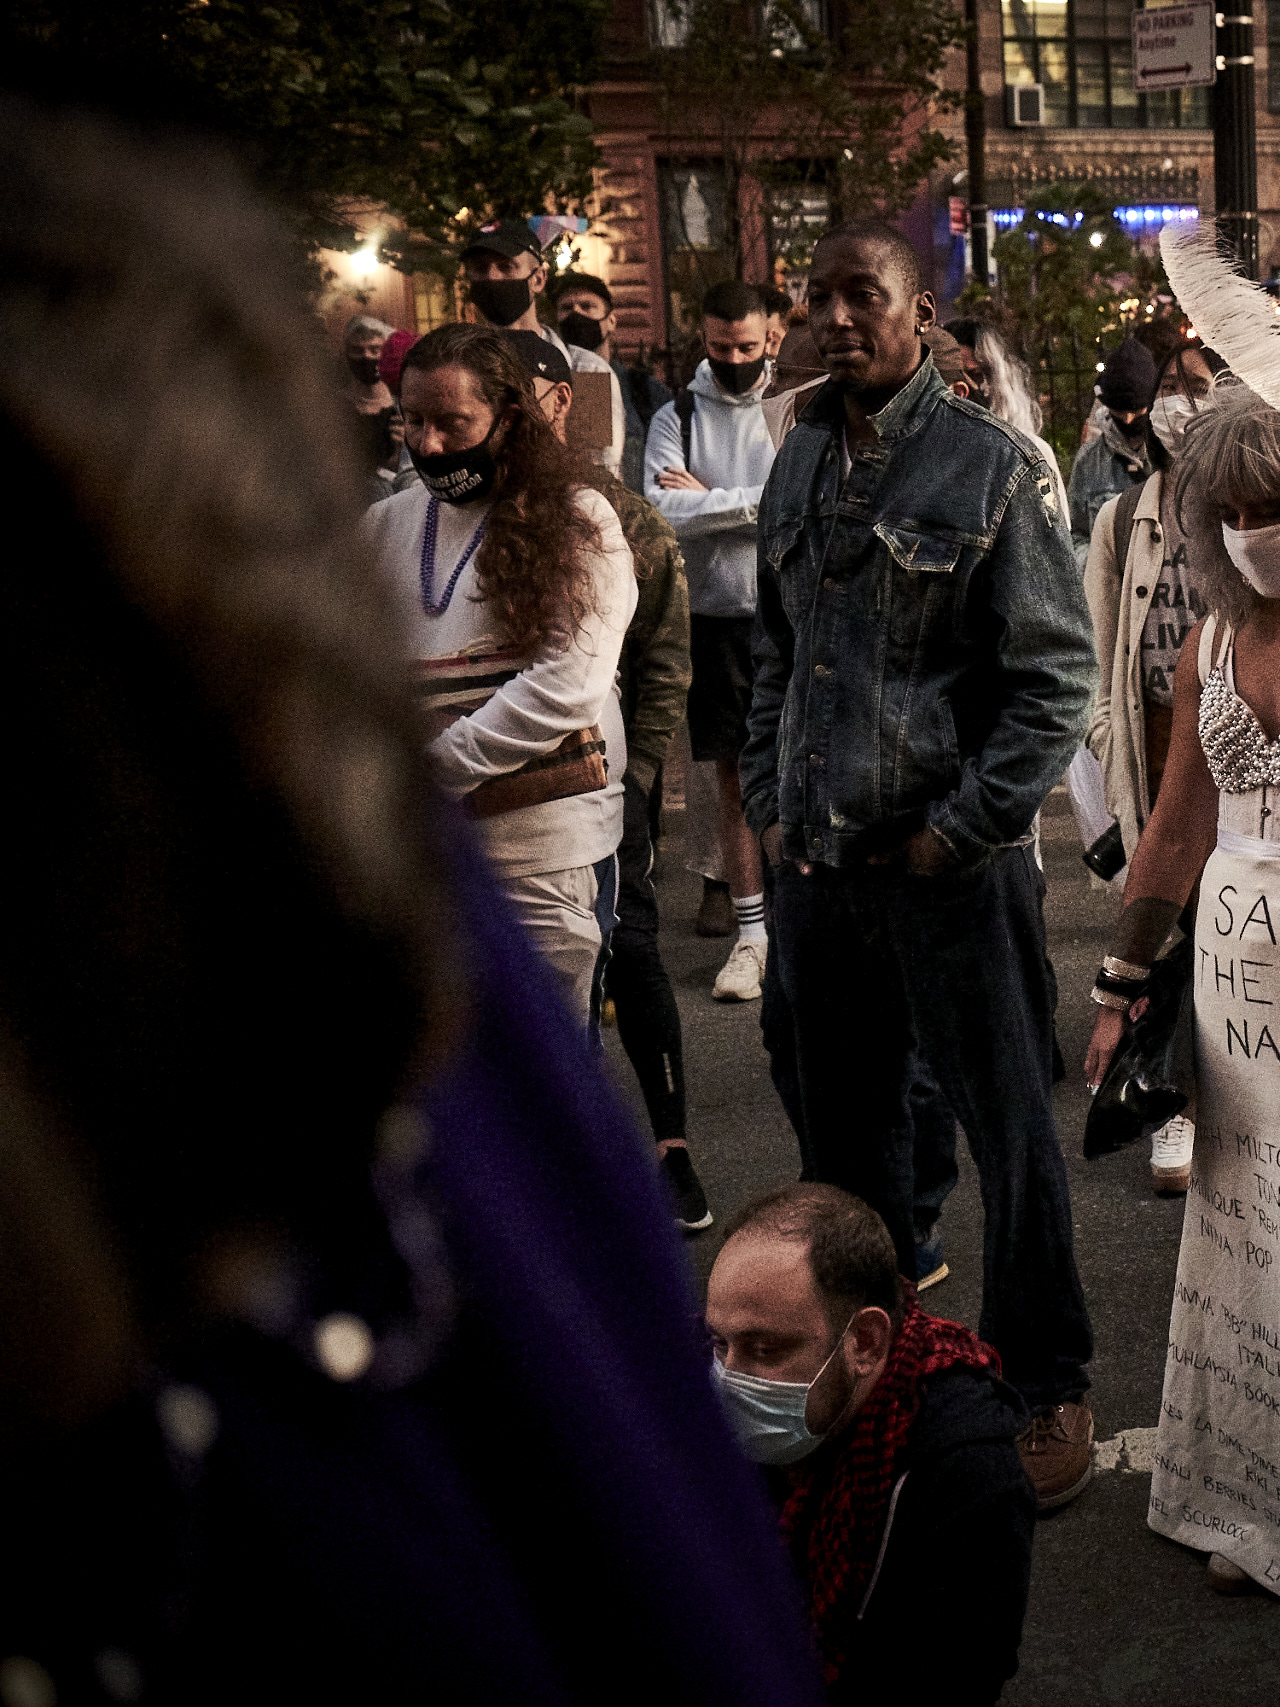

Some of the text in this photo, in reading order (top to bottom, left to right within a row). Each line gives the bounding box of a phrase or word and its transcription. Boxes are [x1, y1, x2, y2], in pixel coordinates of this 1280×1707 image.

[448, 473, 483, 498] TAYLOR
[449, 468, 469, 485] FOR
[1201, 1215, 1273, 1273] NINA POP
[1238, 1343, 1280, 1377] ITALI
[1194, 1416, 1212, 1434] LA
[1218, 1429, 1246, 1457] DIME
[1203, 1476, 1256, 1511] BERRIES
[1182, 1505, 1249, 1541] SCURLOCK
